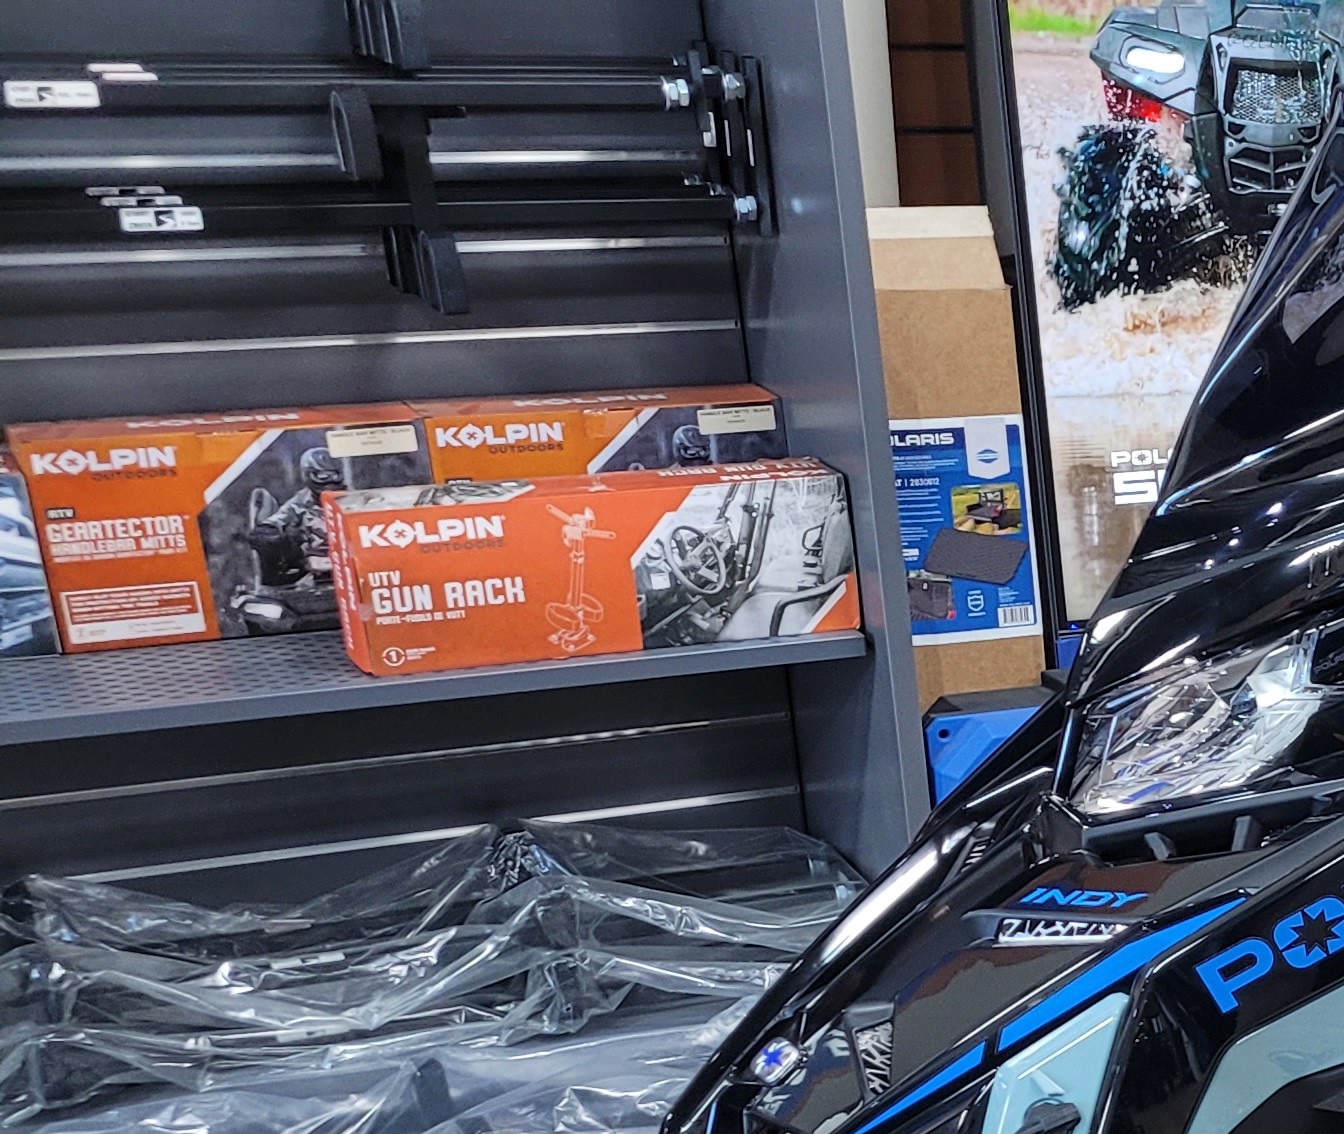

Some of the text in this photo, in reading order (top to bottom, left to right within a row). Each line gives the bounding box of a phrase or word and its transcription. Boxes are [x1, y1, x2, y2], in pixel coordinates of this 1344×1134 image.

[435, 422, 564, 449] KOLPIN
[890, 432, 955, 447] LARIS
[489, 443, 564, 454] OUTDOORS
[1110, 448, 1174, 468] POL
[30, 446, 178, 475] KOLPIN
[46, 515, 184, 543] GEARTECTOR
[358, 514, 505, 548] KOLPIN
[140, 535, 187, 549] MITTS
[421, 541, 505, 553] OUTDOORS
[368, 570, 400, 588] UTV
[370, 576, 526, 614] GUN RACK
[1018, 886, 1149, 909] INDY
